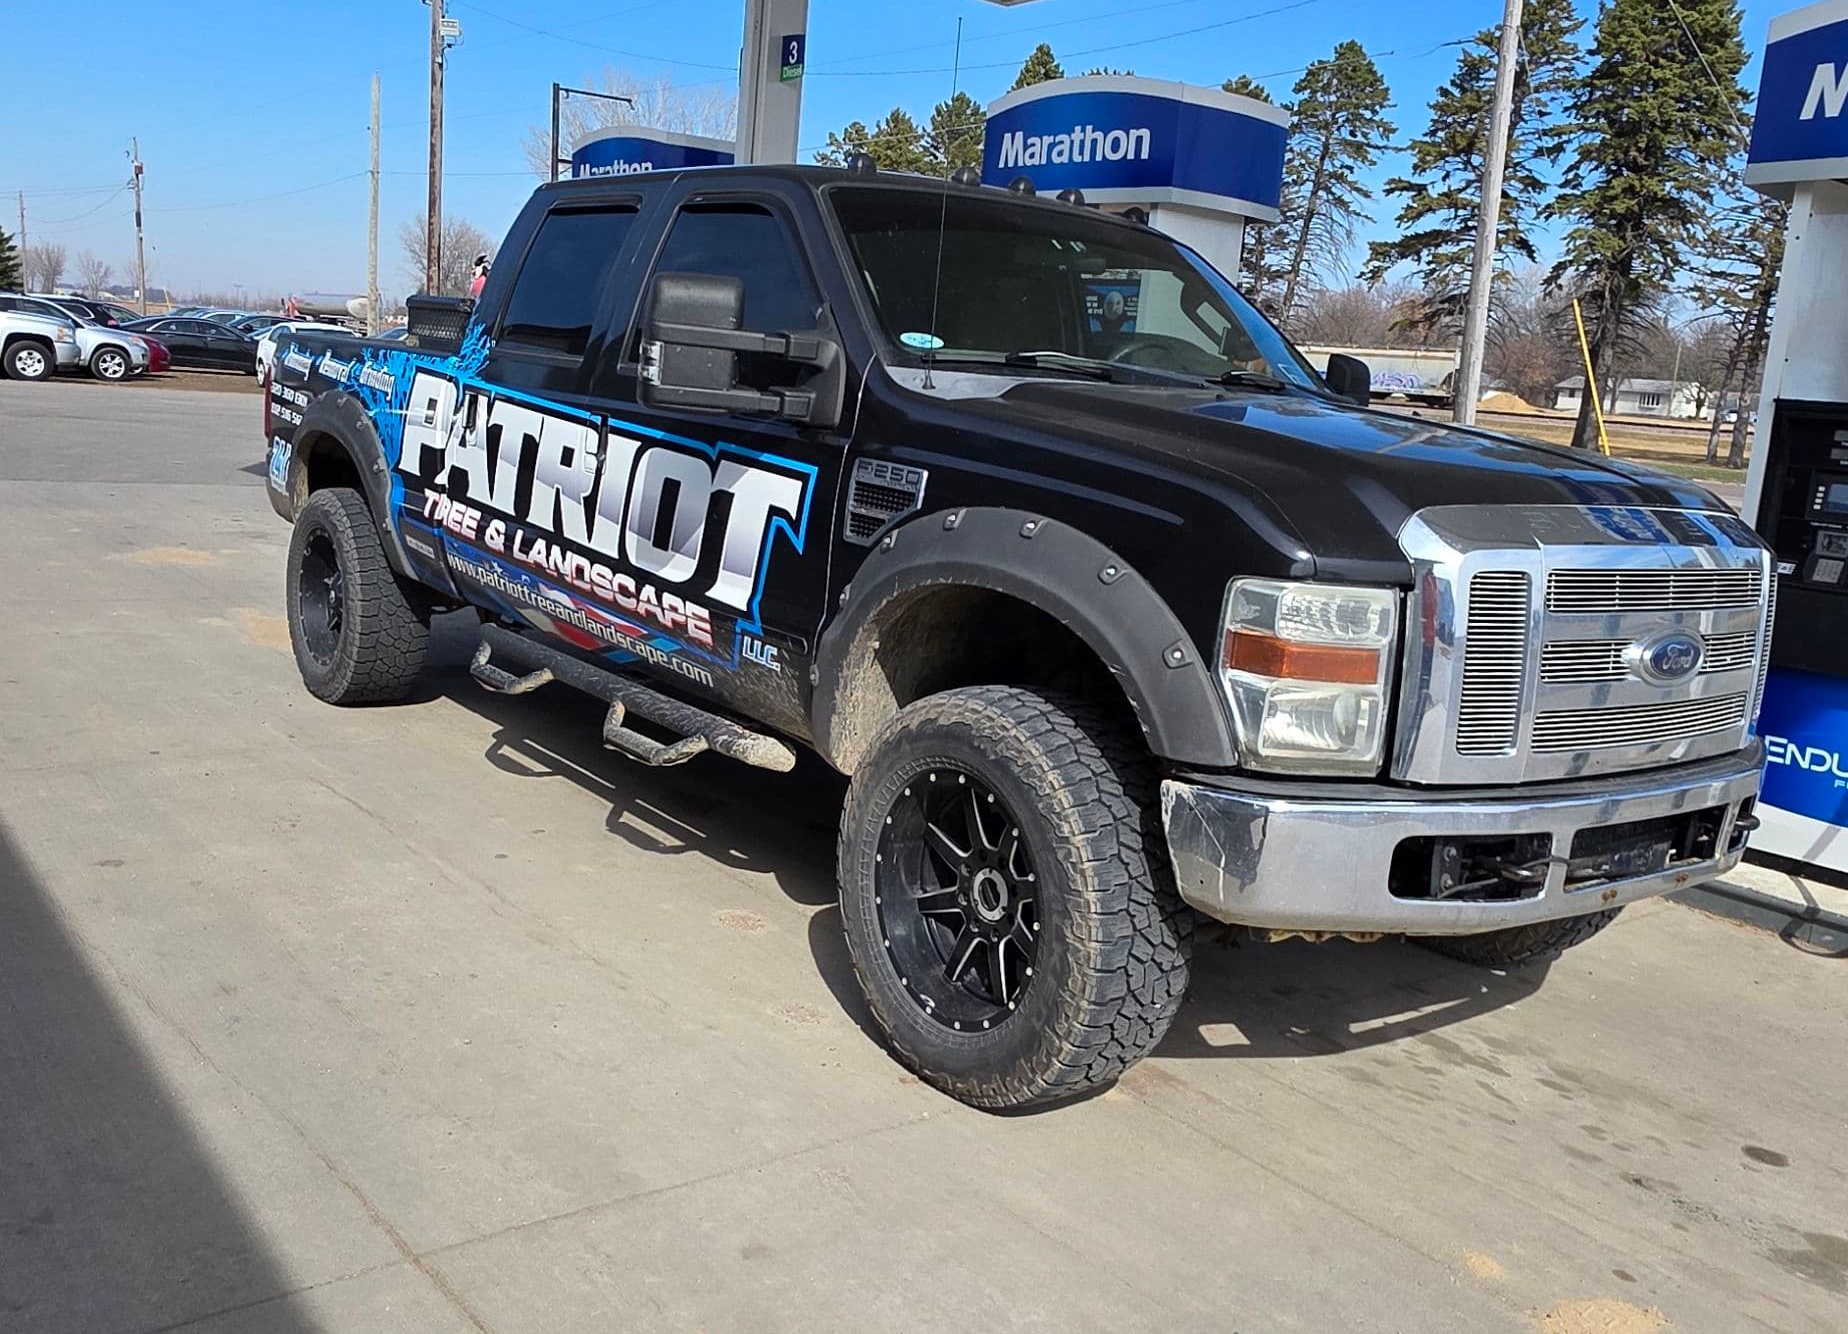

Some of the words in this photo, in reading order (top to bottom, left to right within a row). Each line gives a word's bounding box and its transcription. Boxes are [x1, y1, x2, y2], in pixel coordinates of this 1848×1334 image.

[788, 40, 799, 65] 3
[998, 125, 1151, 169] Marathon
[398, 371, 803, 612] PATRIOT
[423, 487, 482, 541] TREE
[484, 518, 507, 555] &
[513, 528, 714, 648] LANDSCAPE
[446, 553, 715, 688] www.patriottreeandlandscape.com
[1662, 643, 1694, 670] Ford
